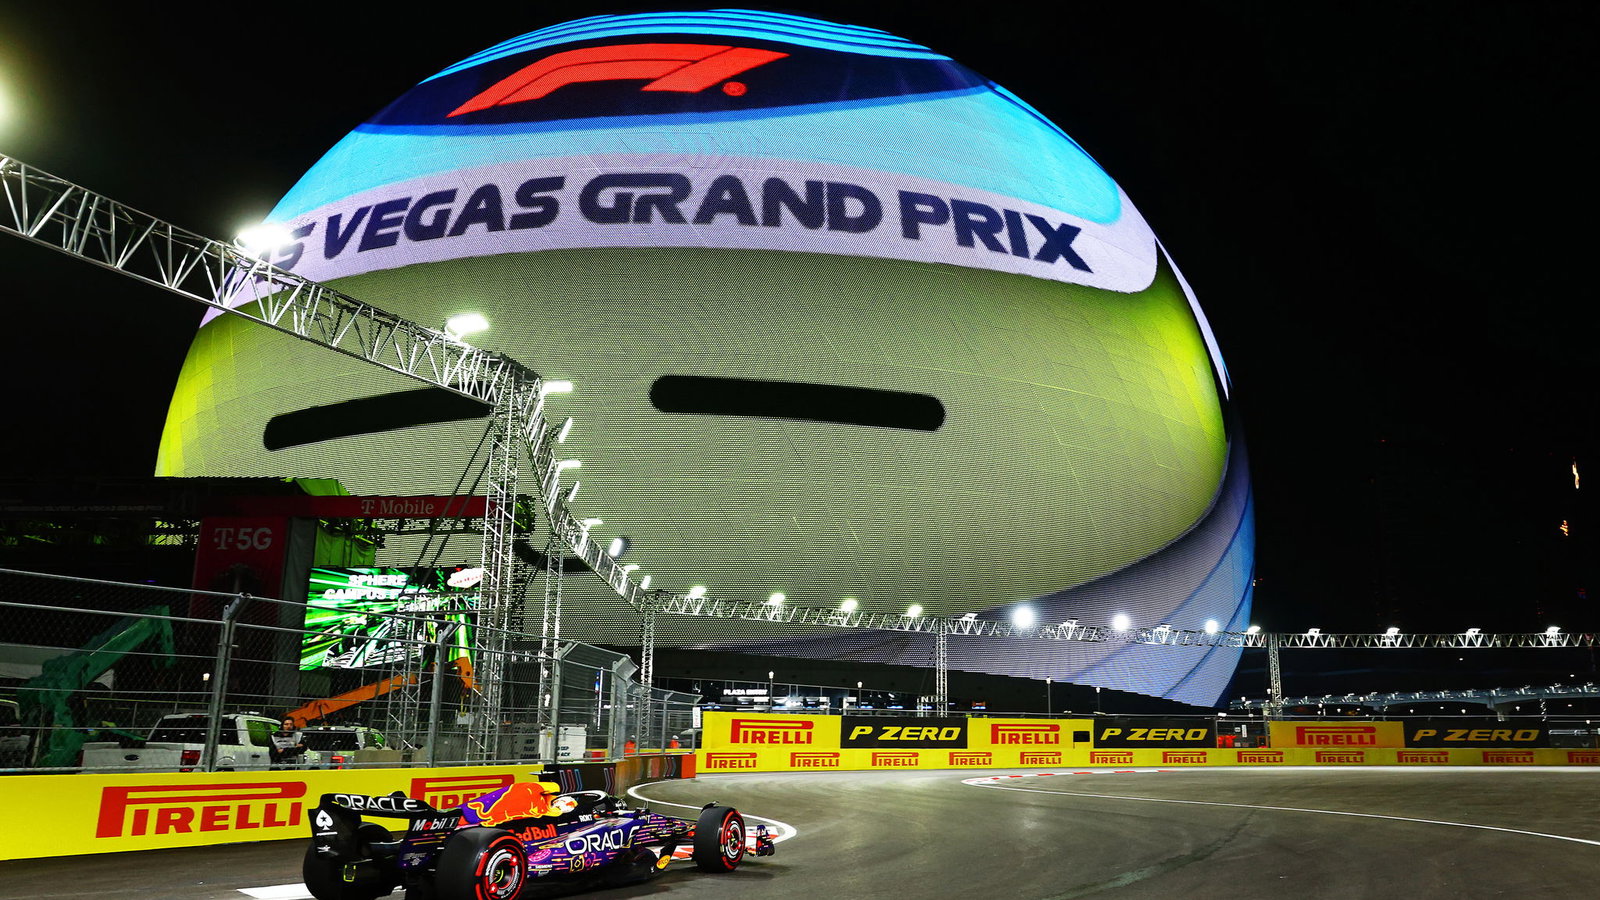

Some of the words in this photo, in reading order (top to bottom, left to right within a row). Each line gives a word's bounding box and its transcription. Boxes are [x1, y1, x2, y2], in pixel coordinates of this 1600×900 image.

[324, 176, 565, 260] VEGAS
[579, 173, 882, 233] GRAND
[899, 189, 1094, 274] PRIX
[380, 500, 434, 515] Mobile
[236, 527, 273, 550] 5G
[349, 575, 407, 586] SPHERE
[730, 719, 814, 744] PIRELLI
[849, 726, 873, 741] P
[877, 726, 962, 741] ZERO
[991, 723, 1060, 745] PIRELLI
[1100, 728, 1122, 741] P
[1126, 728, 1208, 741] ZERO
[1296, 726, 1377, 745] PIRELLI
[1413, 729, 1437, 742] P
[1443, 729, 1540, 742] ZERO
[706, 752, 757, 769] PIRELLI
[790, 752, 840, 767] PIRELLI
[872, 752, 919, 767] PIRELLI
[949, 751, 992, 766] PIRELLI
[1019, 751, 1062, 765] PIRELLI
[1089, 751, 1133, 764] PIRELLI
[1162, 751, 1207, 763] PIRELLI
[1237, 751, 1284, 763] PIRELLI
[1315, 751, 1365, 763] PIRELLI
[1396, 751, 1449, 763] PIRELLI
[1483, 751, 1535, 763] PIRELLI
[334, 794, 419, 811] ORACLE
[96, 783, 307, 839] PIRELLI
[412, 817, 447, 832] Mobil
[531, 824, 558, 840] Bull
[565, 826, 640, 855] ORACLE
